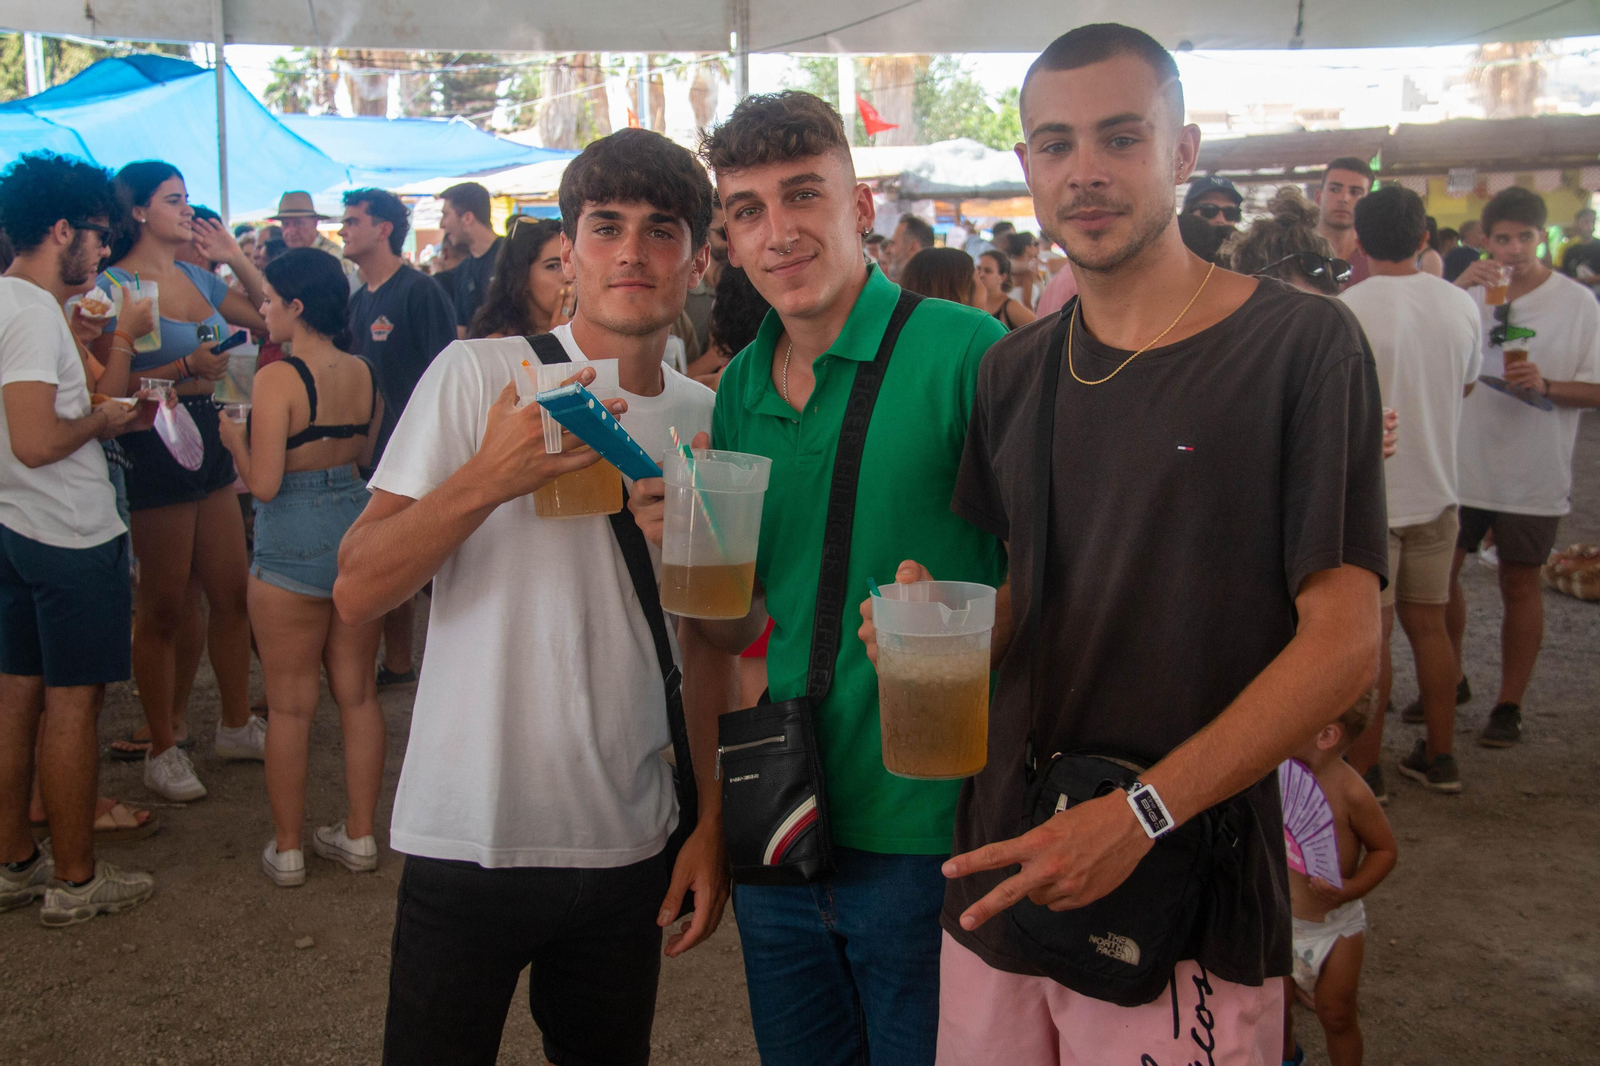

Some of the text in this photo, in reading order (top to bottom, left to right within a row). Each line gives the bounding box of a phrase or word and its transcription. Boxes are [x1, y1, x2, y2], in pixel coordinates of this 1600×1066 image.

[809, 586, 840, 698] HILFIGER
[1088, 934, 1124, 951] NORTH
[1107, 931, 1126, 943] THE
[1095, 944, 1122, 959] FACE
